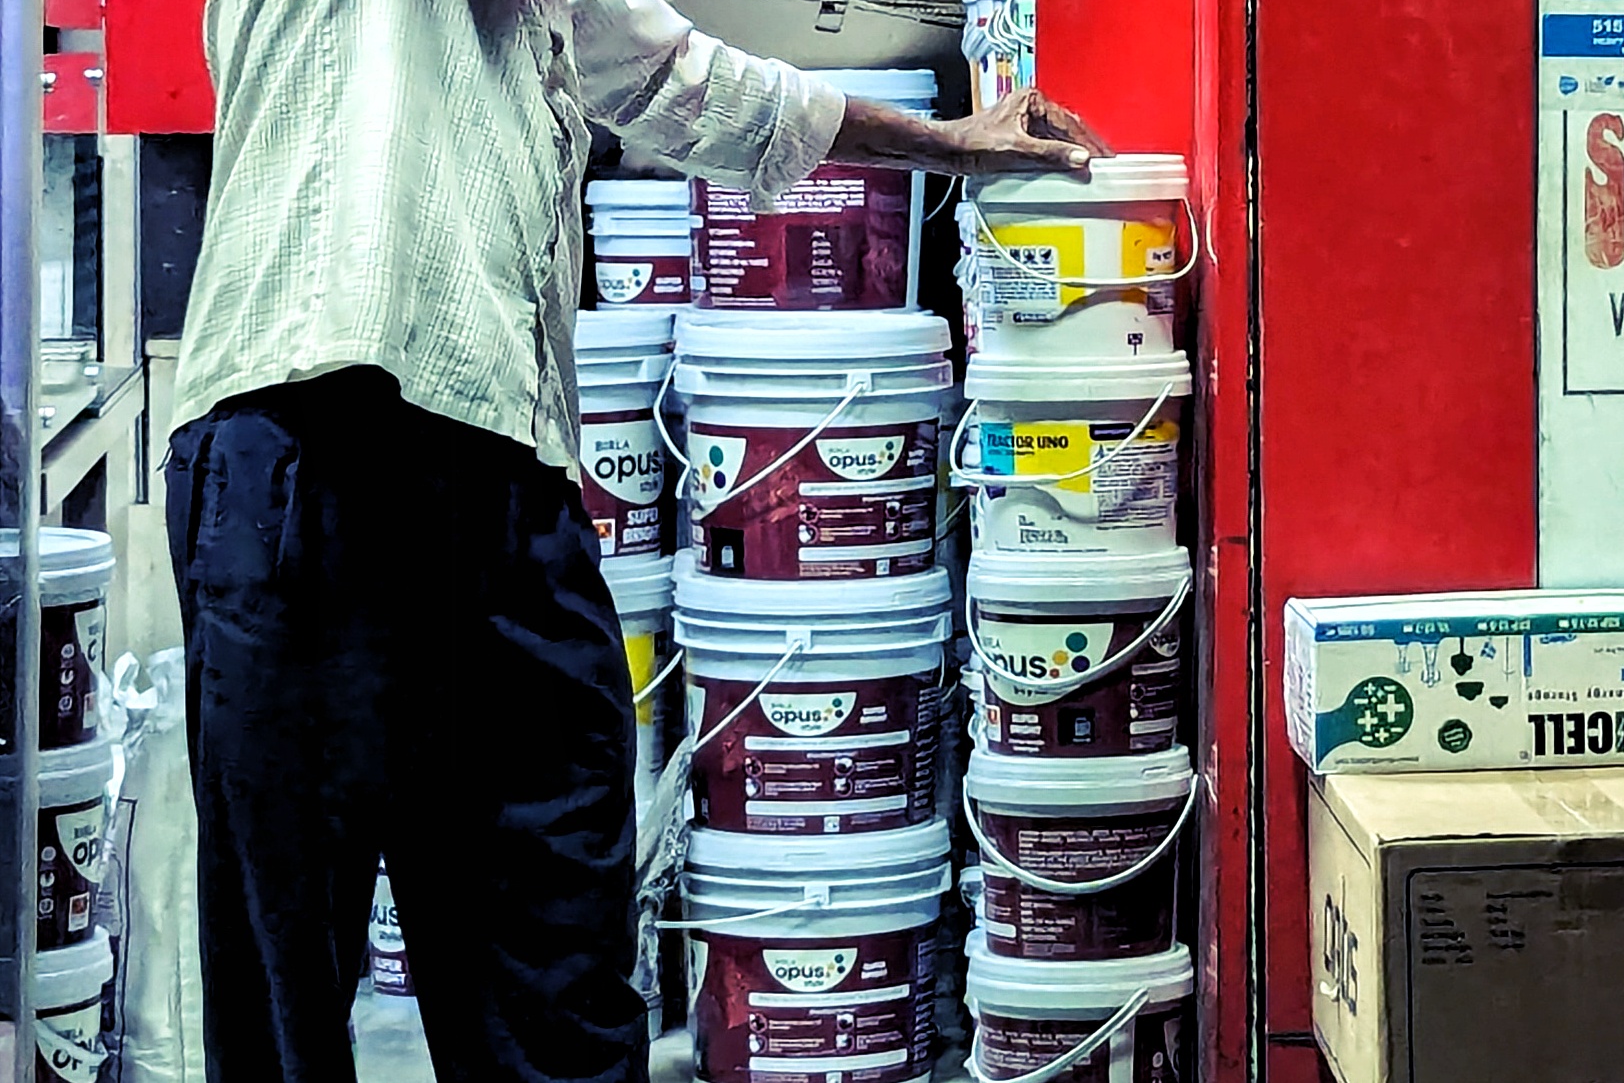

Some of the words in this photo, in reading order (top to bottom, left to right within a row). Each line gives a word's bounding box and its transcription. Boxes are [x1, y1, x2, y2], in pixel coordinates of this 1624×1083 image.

[1037, 436, 1069, 449] UNO
[595, 450, 662, 483] opus
[829, 454, 877, 469] opus
[771, 710, 822, 724] opus
[775, 965, 824, 981] opus
